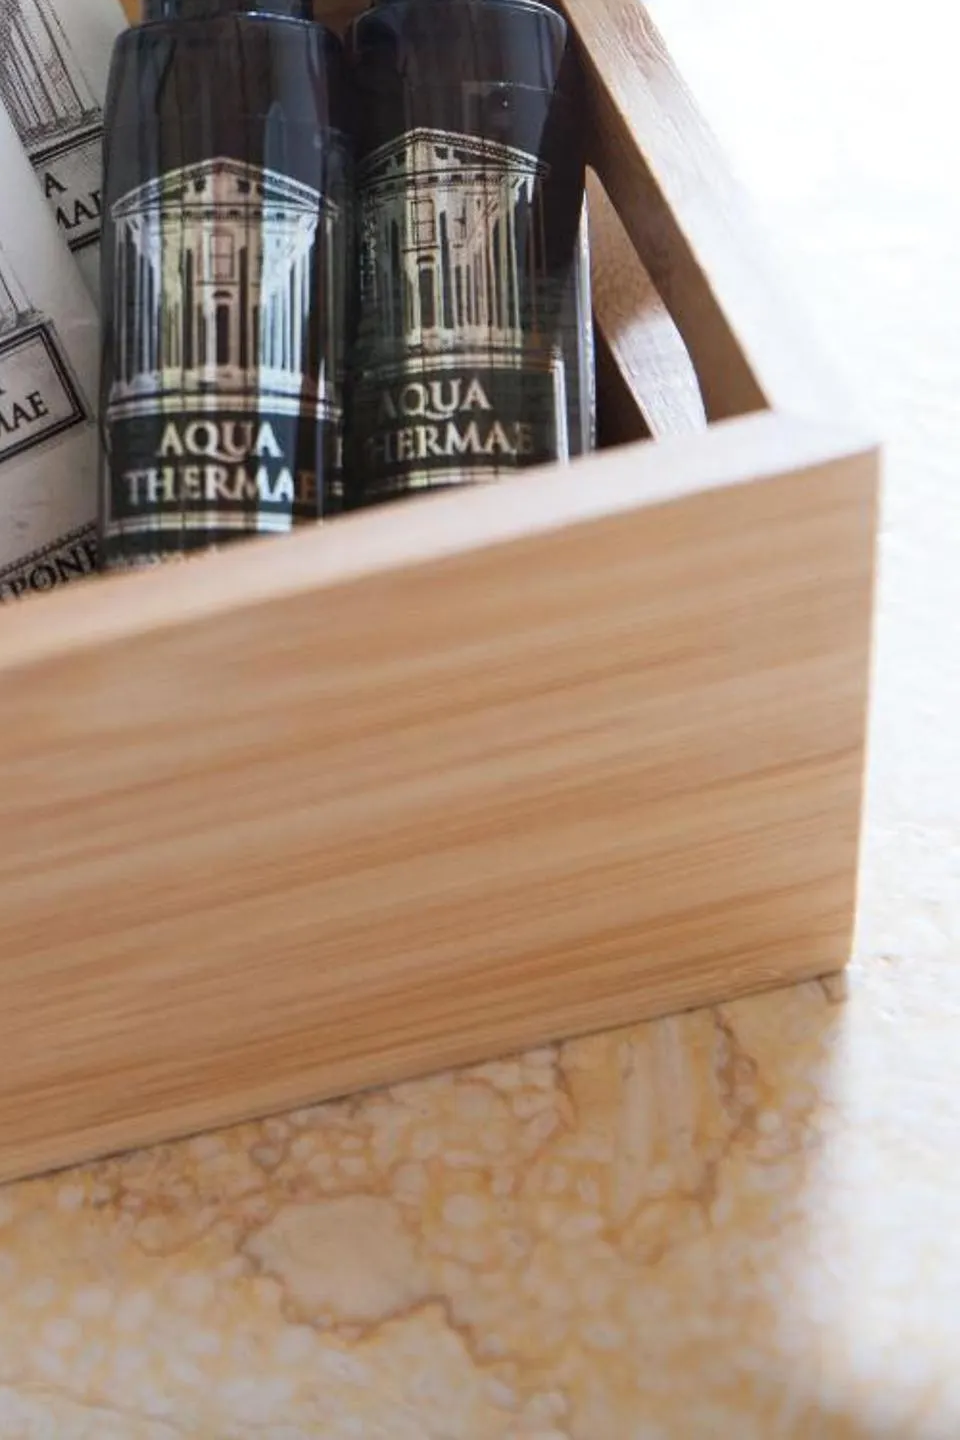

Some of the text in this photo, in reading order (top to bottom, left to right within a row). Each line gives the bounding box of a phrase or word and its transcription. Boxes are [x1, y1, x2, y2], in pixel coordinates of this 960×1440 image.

[377, 376, 493, 421] AQUA
[157, 419, 285, 464] AQUA
[124, 464, 317, 506] THERMAE
